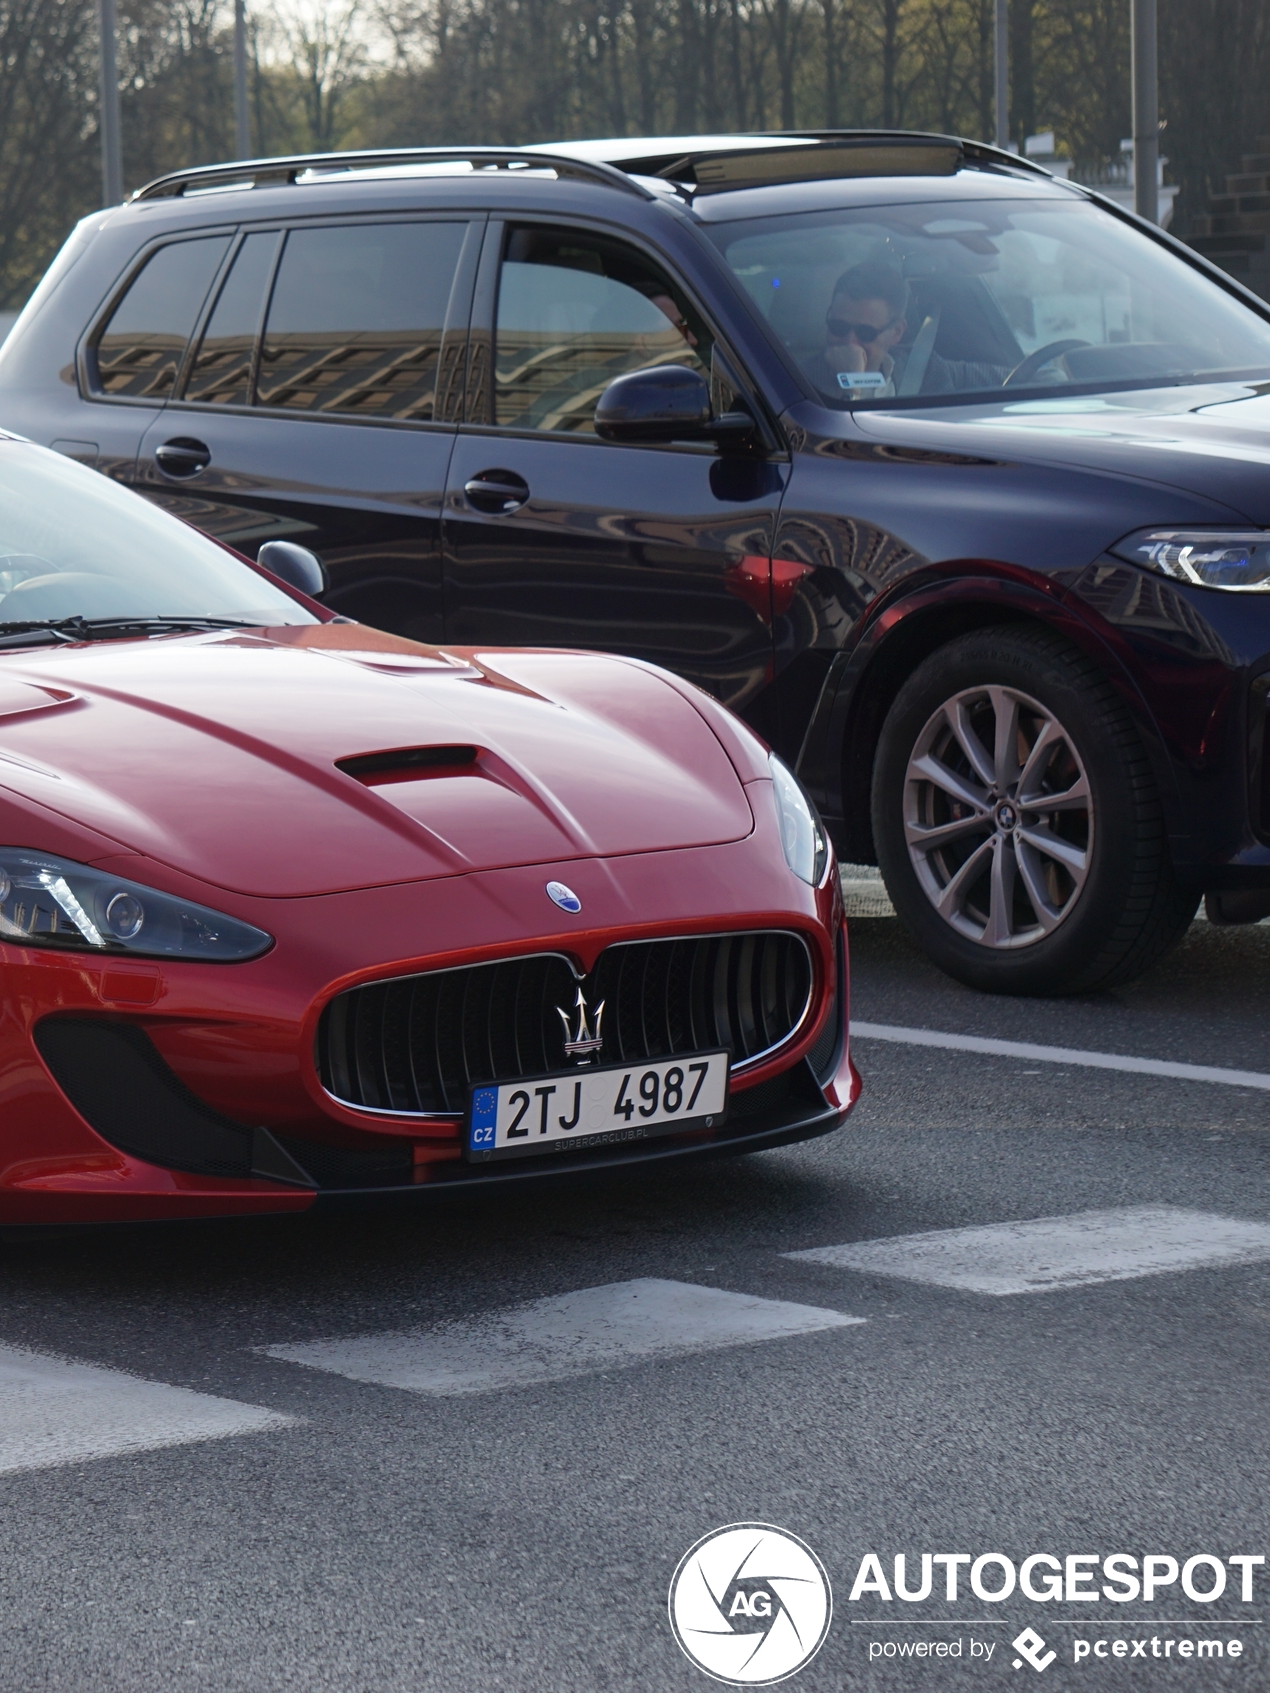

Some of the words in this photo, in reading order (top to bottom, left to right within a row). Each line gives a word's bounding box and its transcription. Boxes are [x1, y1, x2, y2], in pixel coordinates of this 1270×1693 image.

[507, 1081, 581, 1139] 2TJ
[613, 1061, 709, 1121] 4987
[473, 1127, 493, 1142] CZ
[554, 1128, 649, 1151] SUPERCARCLUB.PL
